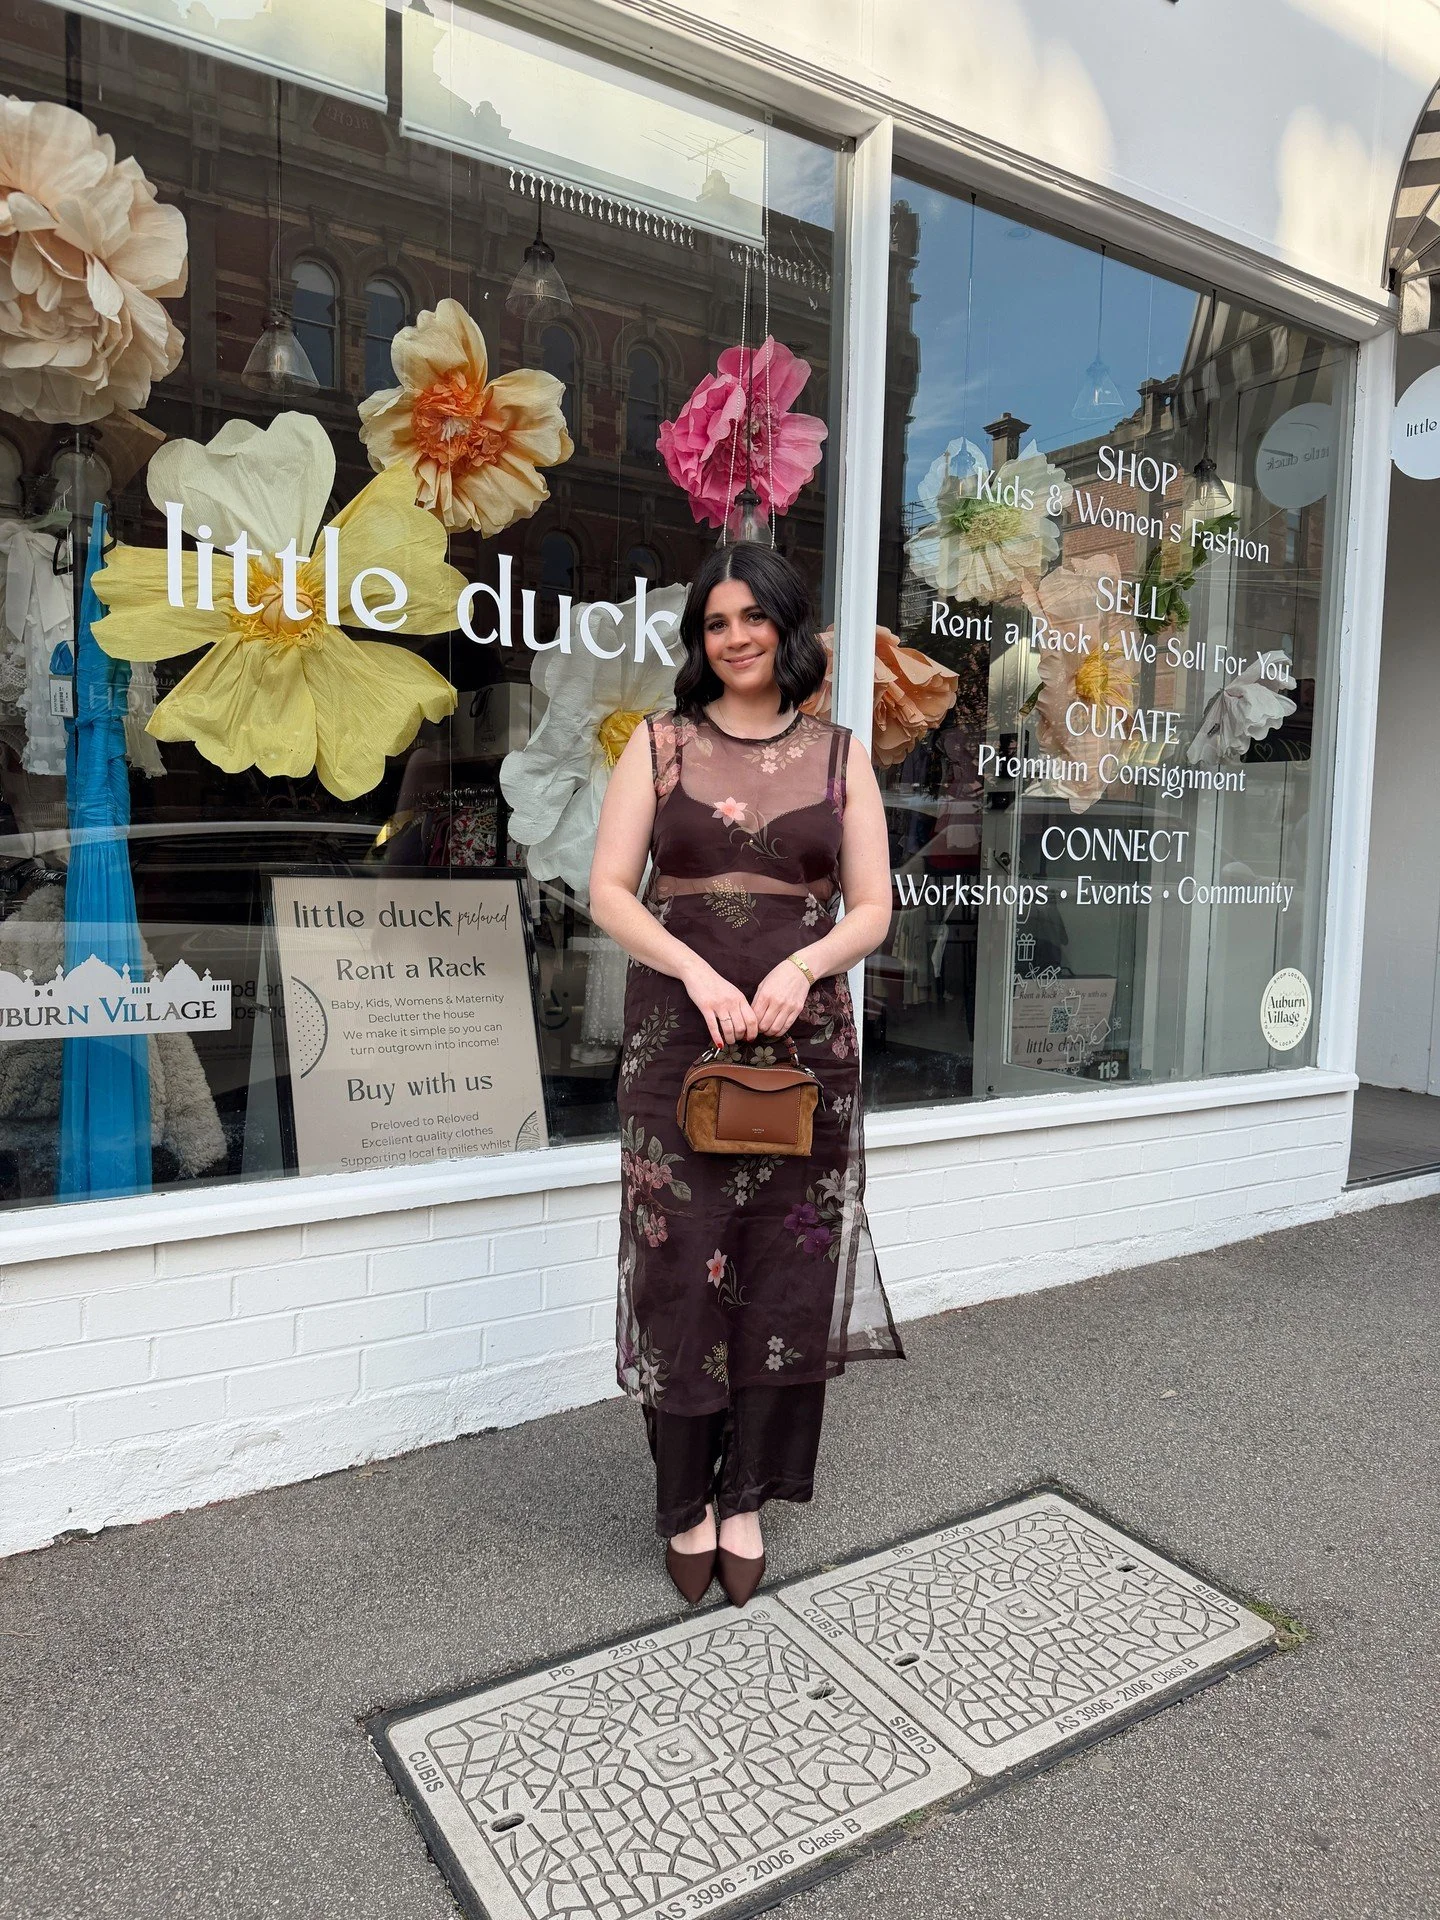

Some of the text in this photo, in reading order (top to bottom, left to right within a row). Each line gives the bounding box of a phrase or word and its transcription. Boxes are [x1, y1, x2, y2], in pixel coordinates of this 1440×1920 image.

[1406, 418, 1438, 437] little
[1097, 445, 1178, 495] SHOP
[976, 467, 1269, 563] Kids & Women's Fashion
[165, 501, 678, 667] little duck
[1096, 576, 1165, 621] SELL
[931, 601, 1290, 684] Rent a Rack We Sell For You
[1065, 701, 1180, 744] CURATE
[977, 744, 1088, 782] Premium
[1098, 754, 1246, 799] Consignment
[1041, 826, 1189, 863] CONNECT
[894, 874, 1294, 915] Workshops Events Community
[293, 901, 510, 936] little duck preloved
[336, 956, 487, 981] Rent a Rack
[0, 1004, 89, 1028] BURN
[99, 997, 217, 1024] VILLAGE
[331, 994, 505, 1011] Baby, Kids, Womens & Maternity
[368, 1010, 475, 1024] Declutter the house
[1267, 1010, 1300, 1026] Village
[1270, 996, 1306, 1009] Auburn
[343, 1023, 503, 1040] We make it simple so you can
[350, 1038, 500, 1056] turn outgrown into income!
[1026, 1038, 1054, 1054] little
[1098, 1060, 1120, 1079] 113
[347, 1072, 493, 1106] Buy with us
[361, 1126, 494, 1149] Excellent quality clothes
[370, 1112, 479, 1132] Preloved to Reloved
[340, 1151, 406, 1168] Supporting
[408, 1146, 435, 1159] local
[480, 1138, 511, 1151] whilst
[892, 1525, 975, 1559] P6 25Kg
[1192, 1584, 1239, 1614] CUBIS
[803, 1608, 843, 1639] CUBIS
[547, 1638, 658, 1681] P6 25Kg
[1054, 1716, 1081, 1735] AS
[1152, 1665, 1188, 1685] Class
[1183, 1657, 1200, 1670] B
[889, 1715, 937, 1755] CUBIS
[408, 1751, 445, 1793] CUBIS
[654, 1902, 687, 1920] AS
[797, 1828, 845, 1856] Class
[841, 1817, 862, 1834] B
